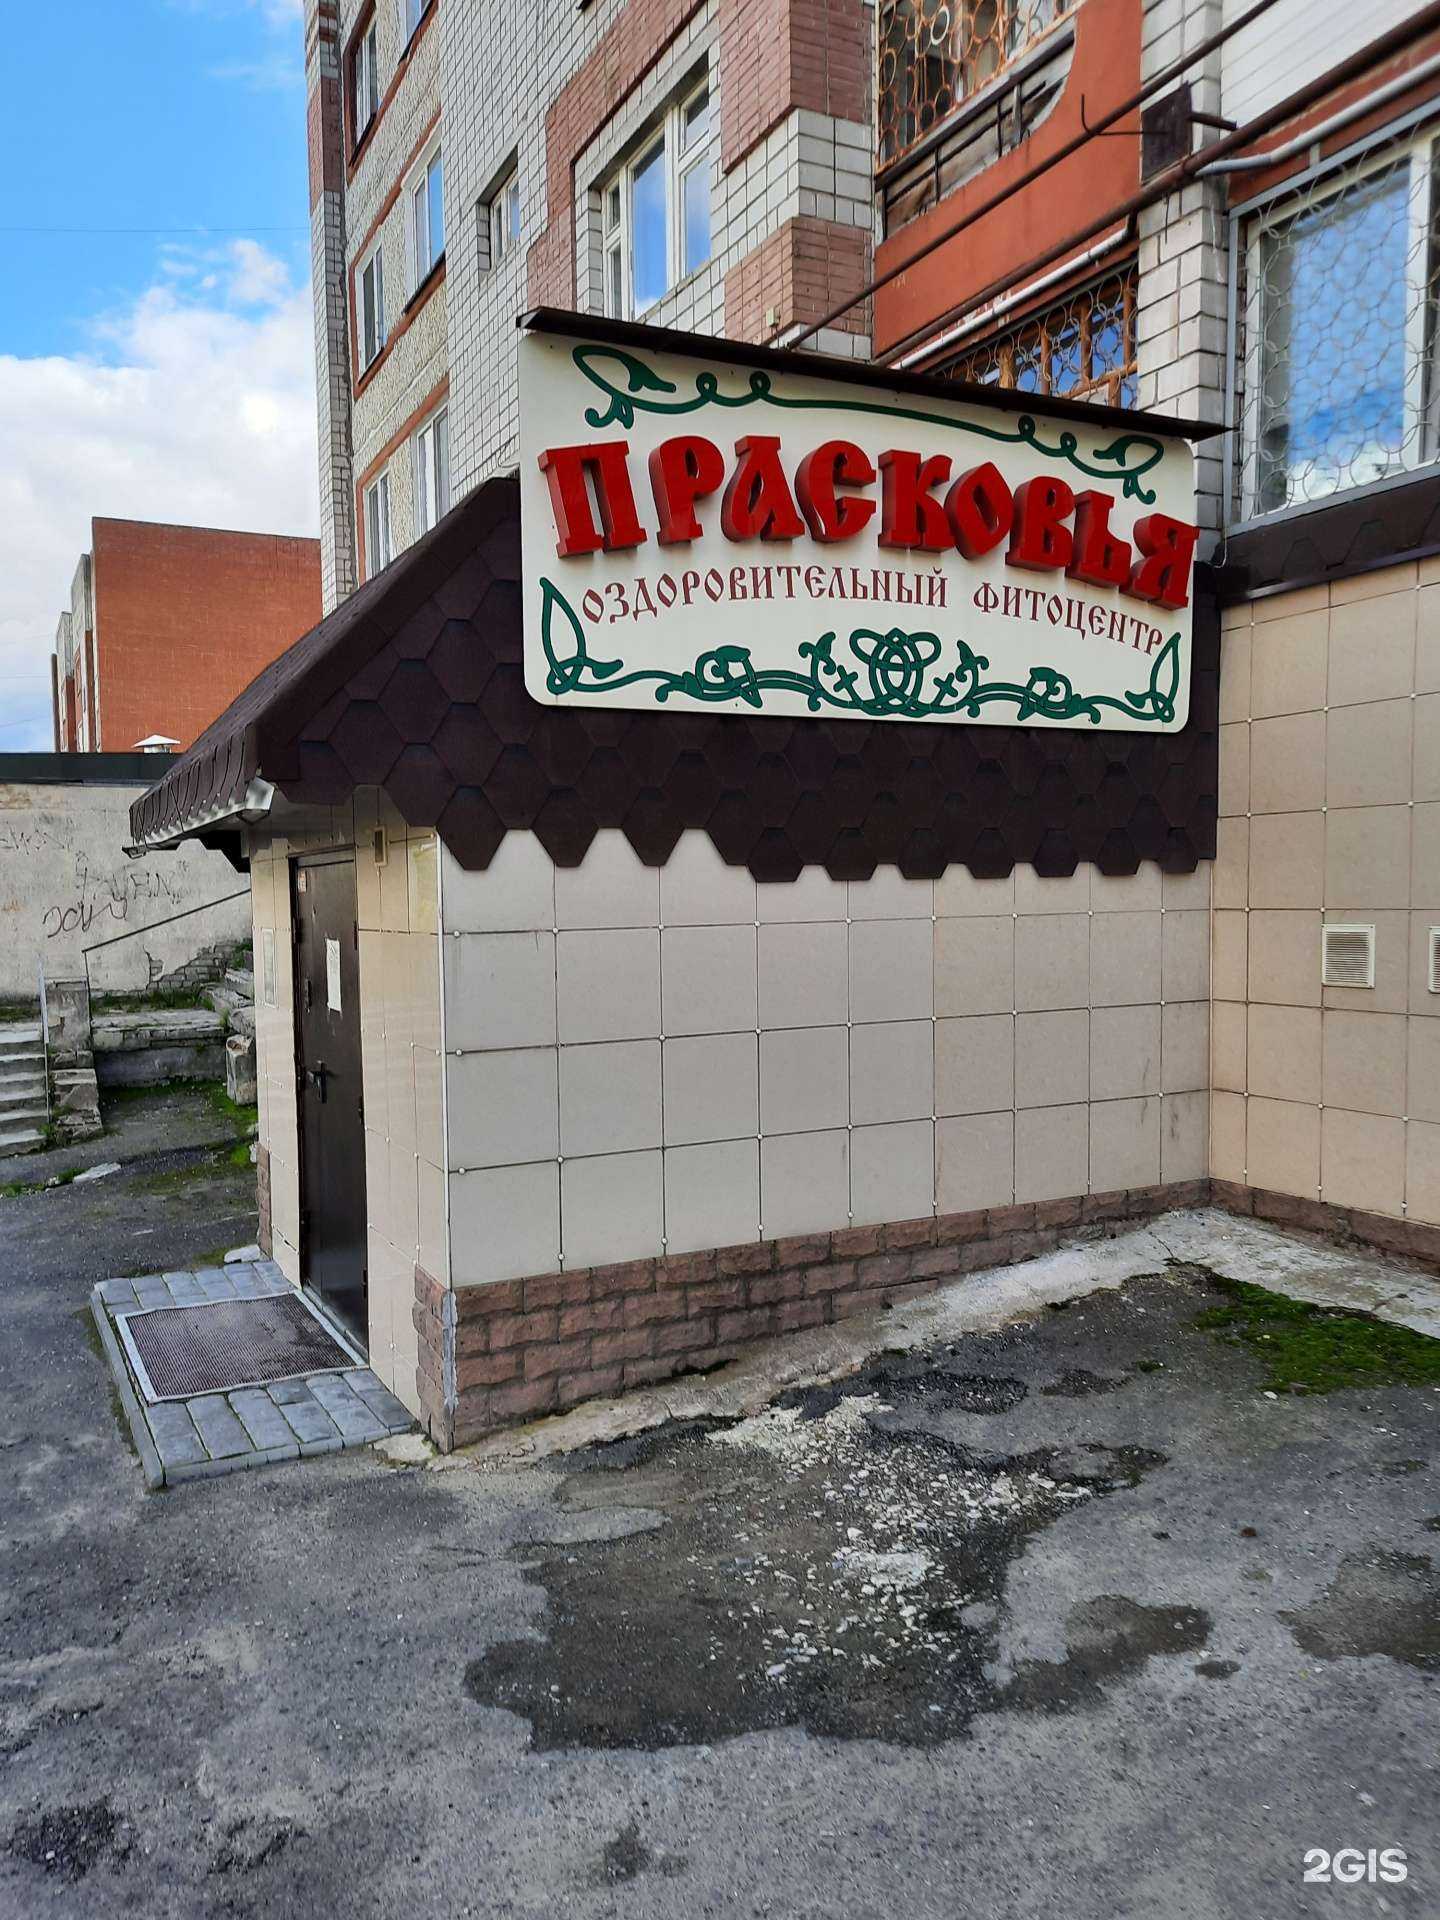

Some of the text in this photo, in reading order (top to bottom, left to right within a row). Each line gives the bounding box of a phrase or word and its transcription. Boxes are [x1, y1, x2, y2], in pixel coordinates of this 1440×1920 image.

[538, 435, 1200, 610] ПРАСКОВЬЯ
[582, 565, 1163, 655] ОЗДОРОВИТЕЛЬНЫЙ ФИТОЦЕНТР
